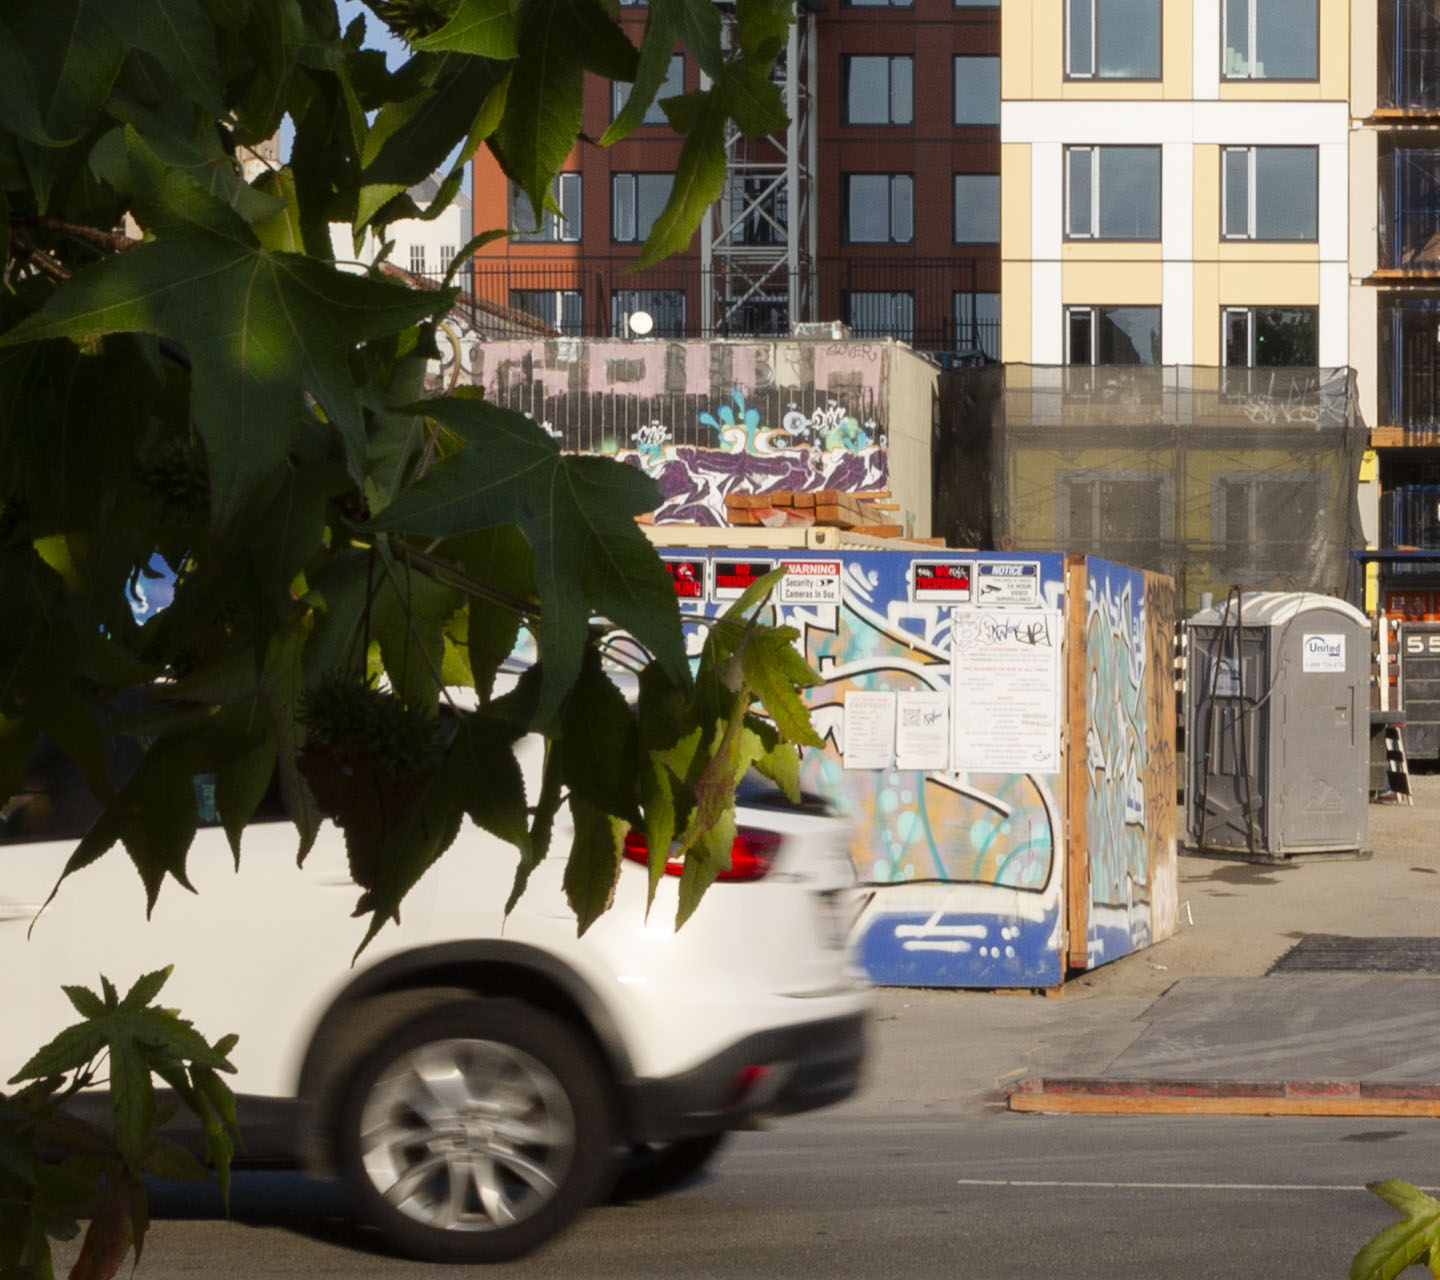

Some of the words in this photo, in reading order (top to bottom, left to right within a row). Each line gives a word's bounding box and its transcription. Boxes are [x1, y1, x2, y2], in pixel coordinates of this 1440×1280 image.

[991, 565, 1024, 576] NOTICE
[785, 578, 813, 589] Security
[785, 589, 813, 599] Cameras
[1309, 641, 1342, 653] United
